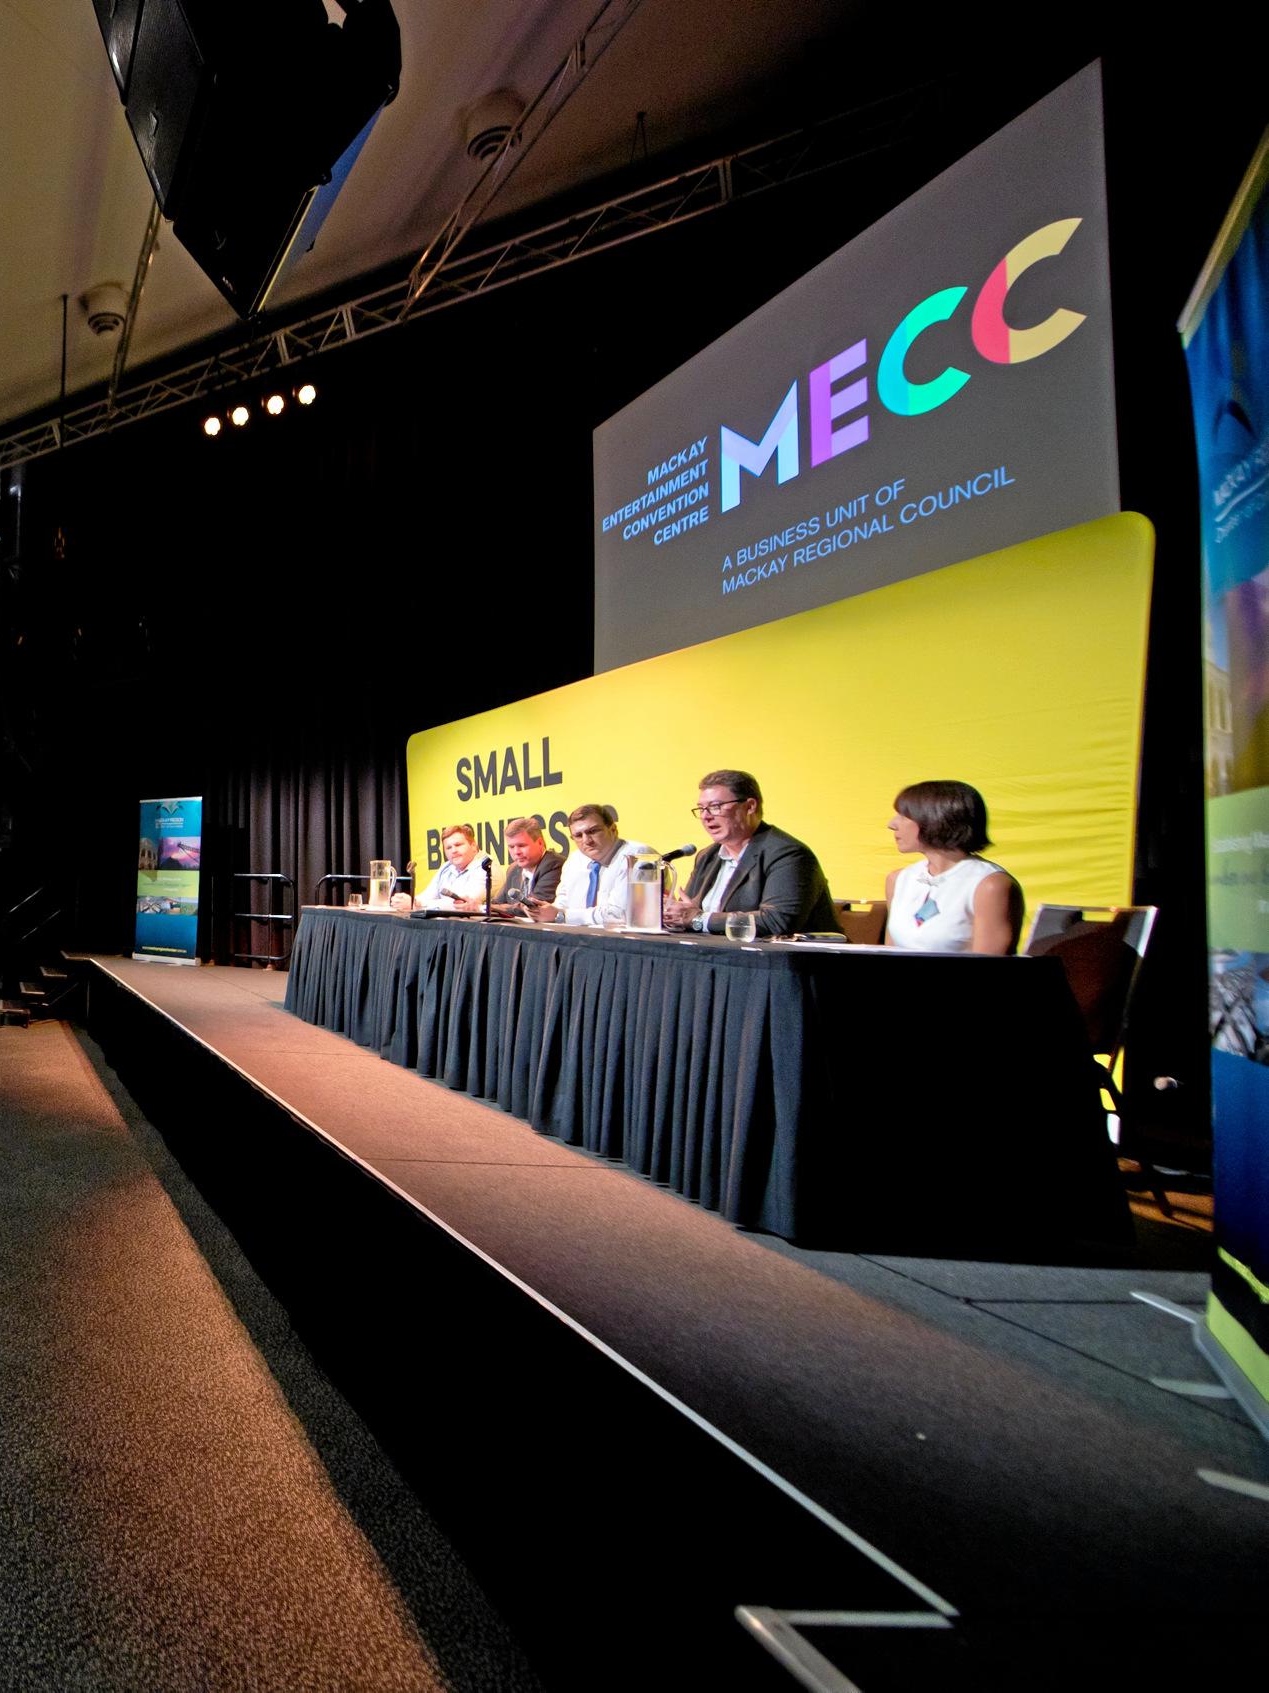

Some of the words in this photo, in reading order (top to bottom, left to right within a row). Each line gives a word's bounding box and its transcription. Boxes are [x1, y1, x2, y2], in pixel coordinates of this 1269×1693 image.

[720, 217, 1088, 514] MECC
[602, 458, 709, 533] ENTERTAINMENT
[647, 436, 708, 486] MACKAY
[623, 481, 710, 541] CONVENTION
[654, 505, 710, 546] CENTRE
[722, 555, 733, 573] A
[736, 516, 820, 567] BUSINESS
[825, 494, 870, 528] UNIT
[875, 478, 906, 507] OF
[722, 553, 788, 595] MACKAY
[793, 514, 895, 568] REGIONAL
[899, 465, 1017, 525] COUNCIL
[456, 736, 563, 802] SMALL
